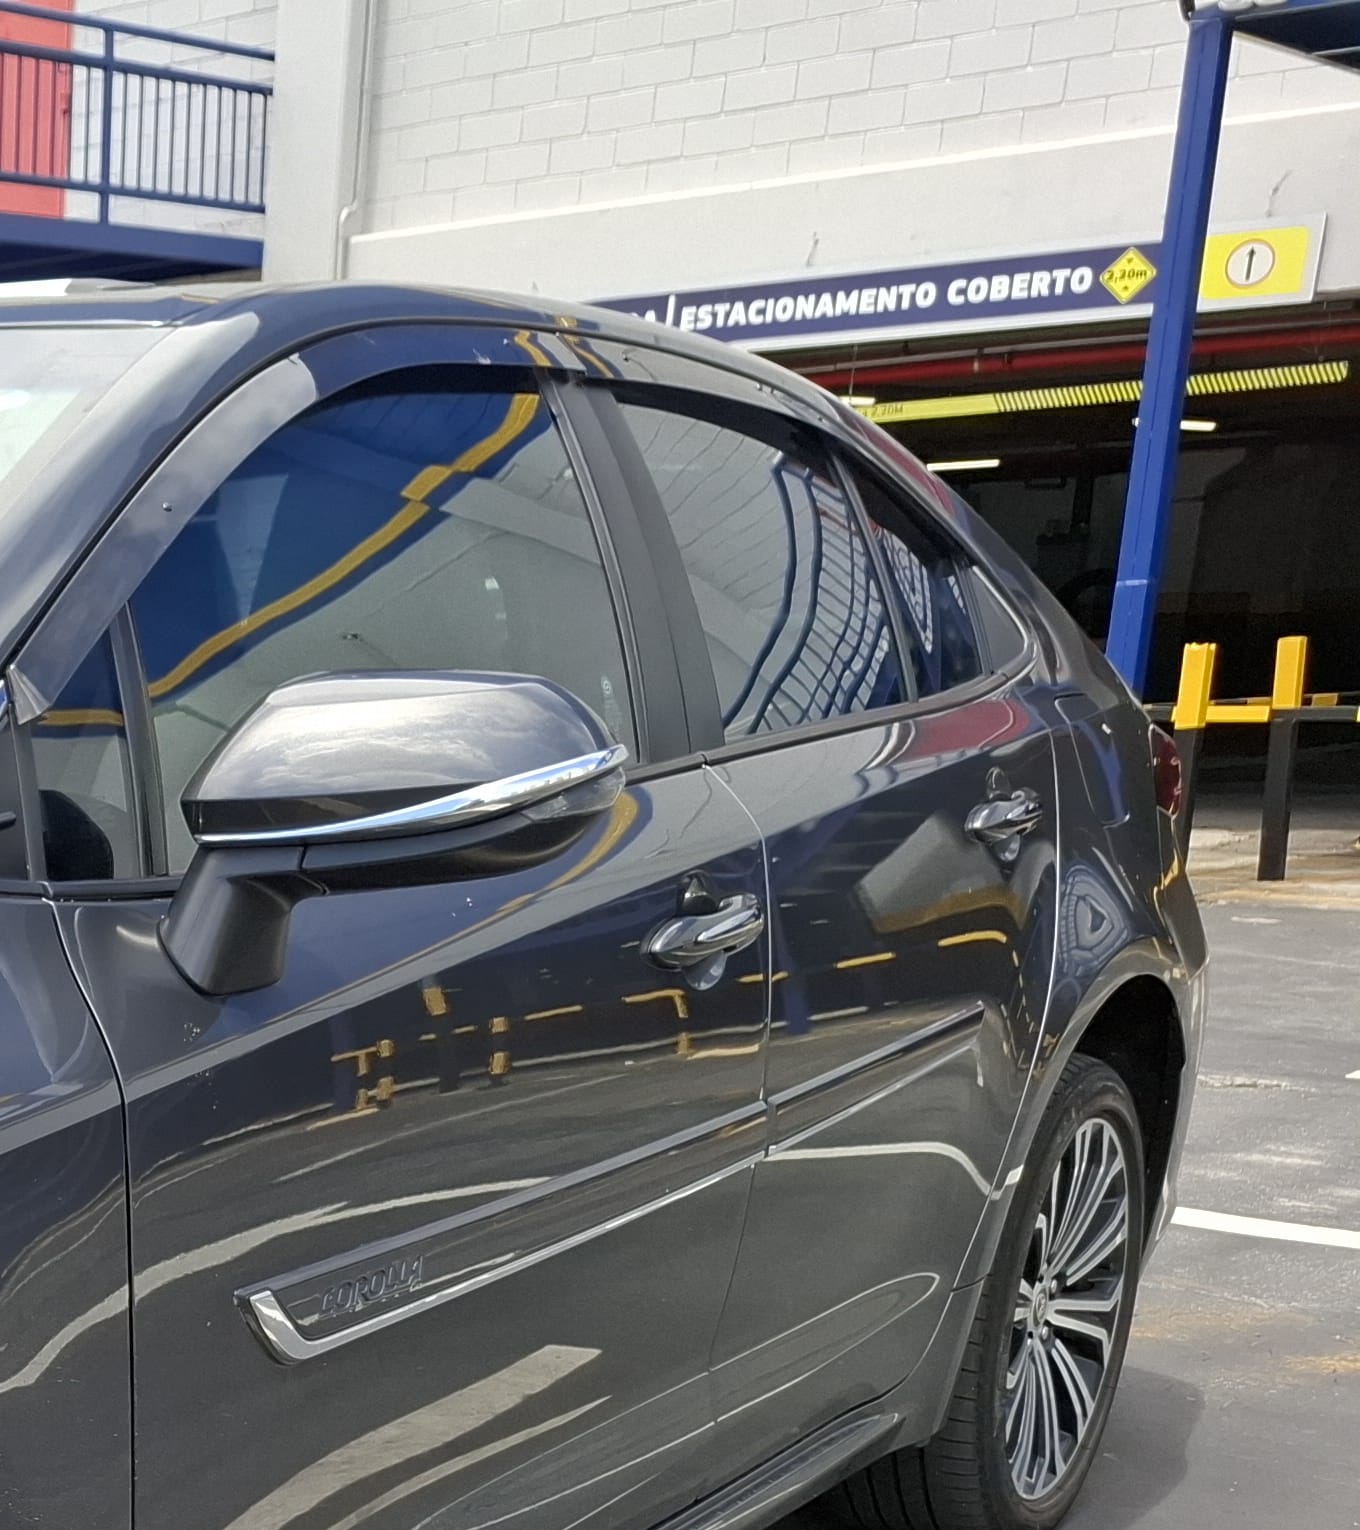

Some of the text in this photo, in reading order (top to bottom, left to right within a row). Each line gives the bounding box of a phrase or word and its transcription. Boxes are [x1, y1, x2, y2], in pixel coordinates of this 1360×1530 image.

[680, 266, 1093, 332] ESTACIONAMENTO COBERTO
[322, 1255, 424, 1311] COROLLA
